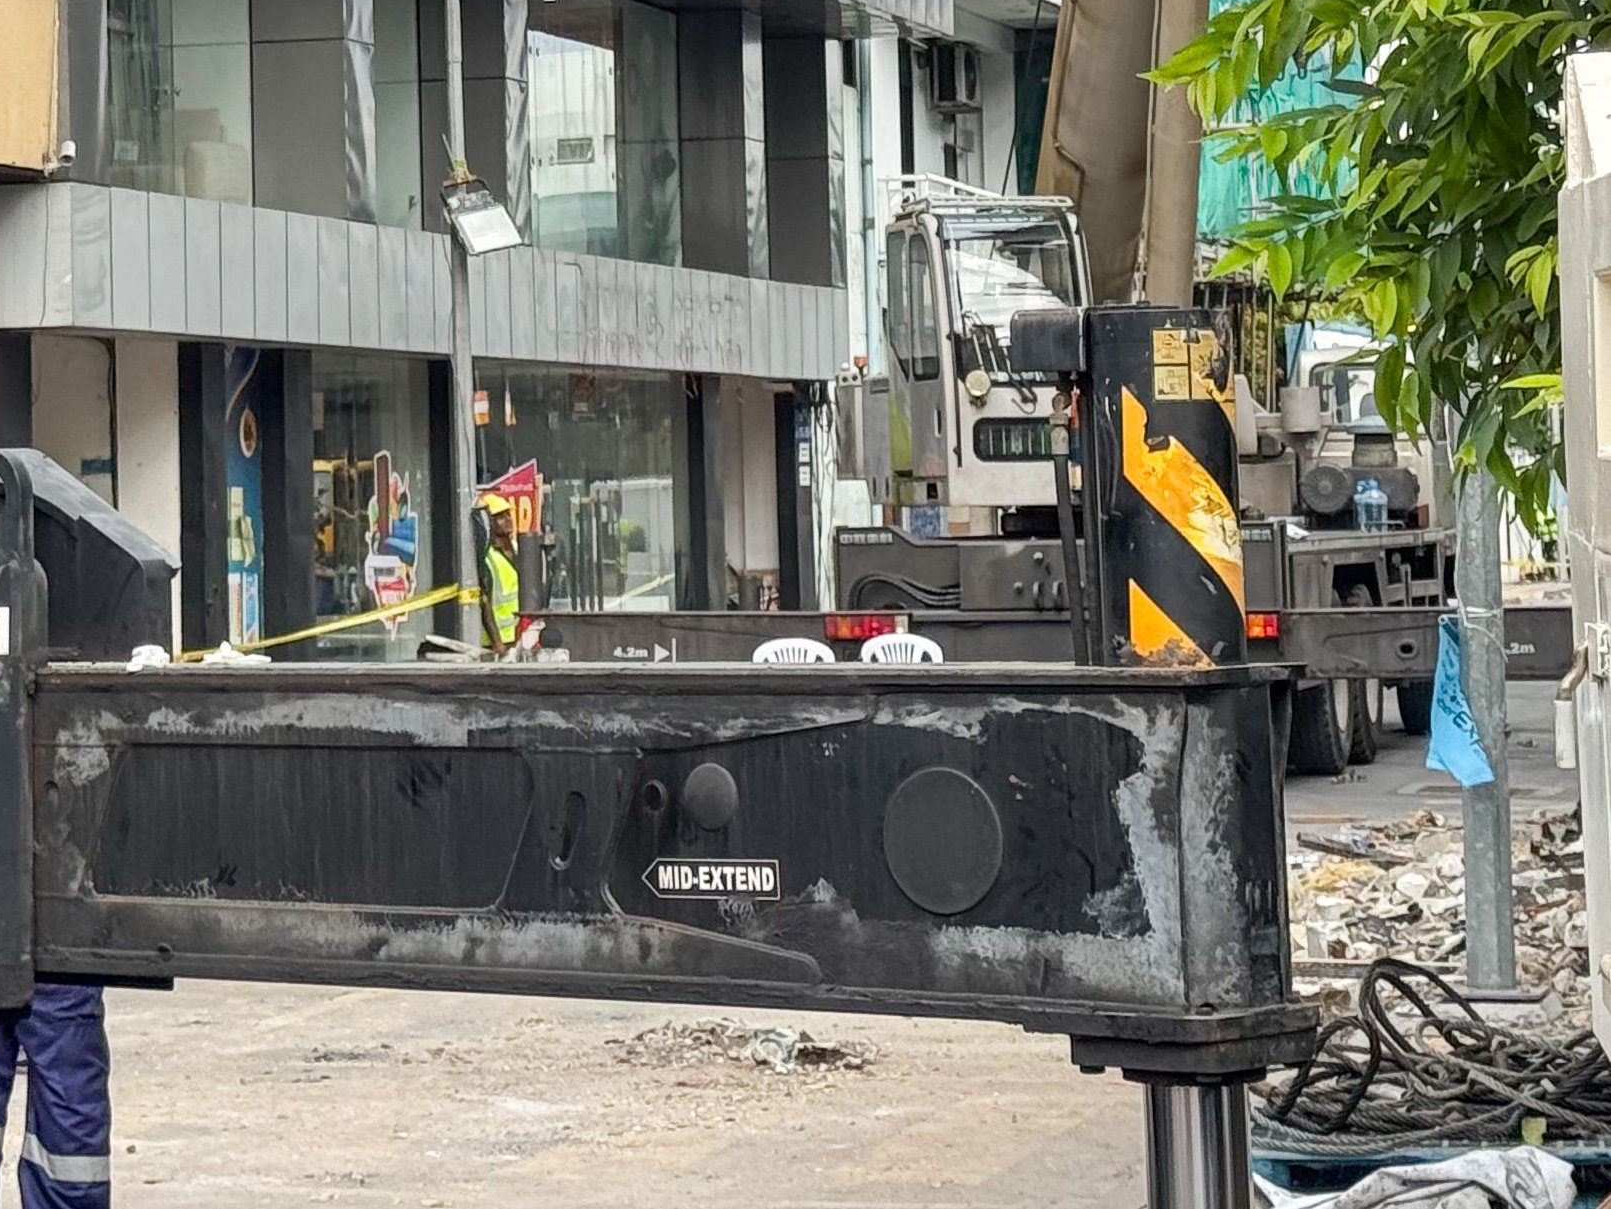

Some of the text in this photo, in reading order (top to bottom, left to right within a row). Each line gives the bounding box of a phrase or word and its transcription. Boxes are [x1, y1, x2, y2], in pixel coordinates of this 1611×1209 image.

[613, 646, 649, 658] 4.2m
[1505, 642, 1536, 655] .2m
[658, 865, 775, 892] MID-EXTEND
